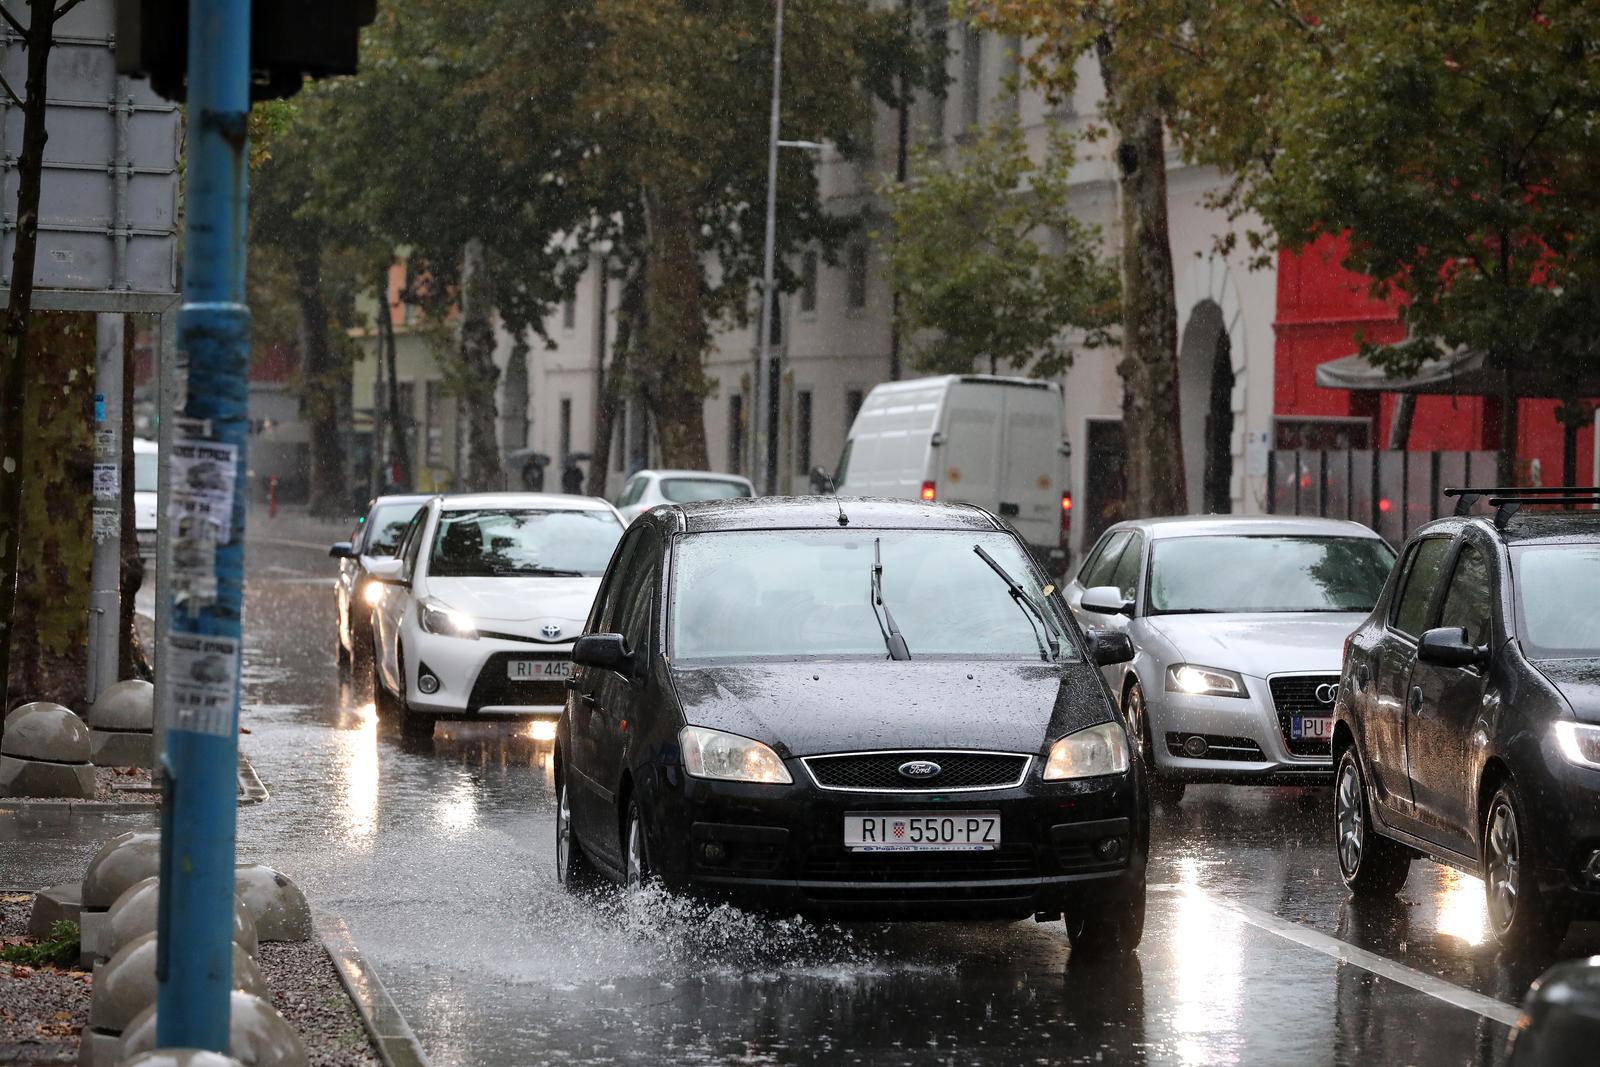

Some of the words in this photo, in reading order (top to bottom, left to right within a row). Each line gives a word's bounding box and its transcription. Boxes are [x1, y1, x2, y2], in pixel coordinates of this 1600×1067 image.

[517, 662, 532, 676] RI
[1303, 719, 1324, 736] PU
[908, 764, 932, 774] Ford
[862, 818, 886, 842] RI
[910, 818, 996, 842] 550-PZ
